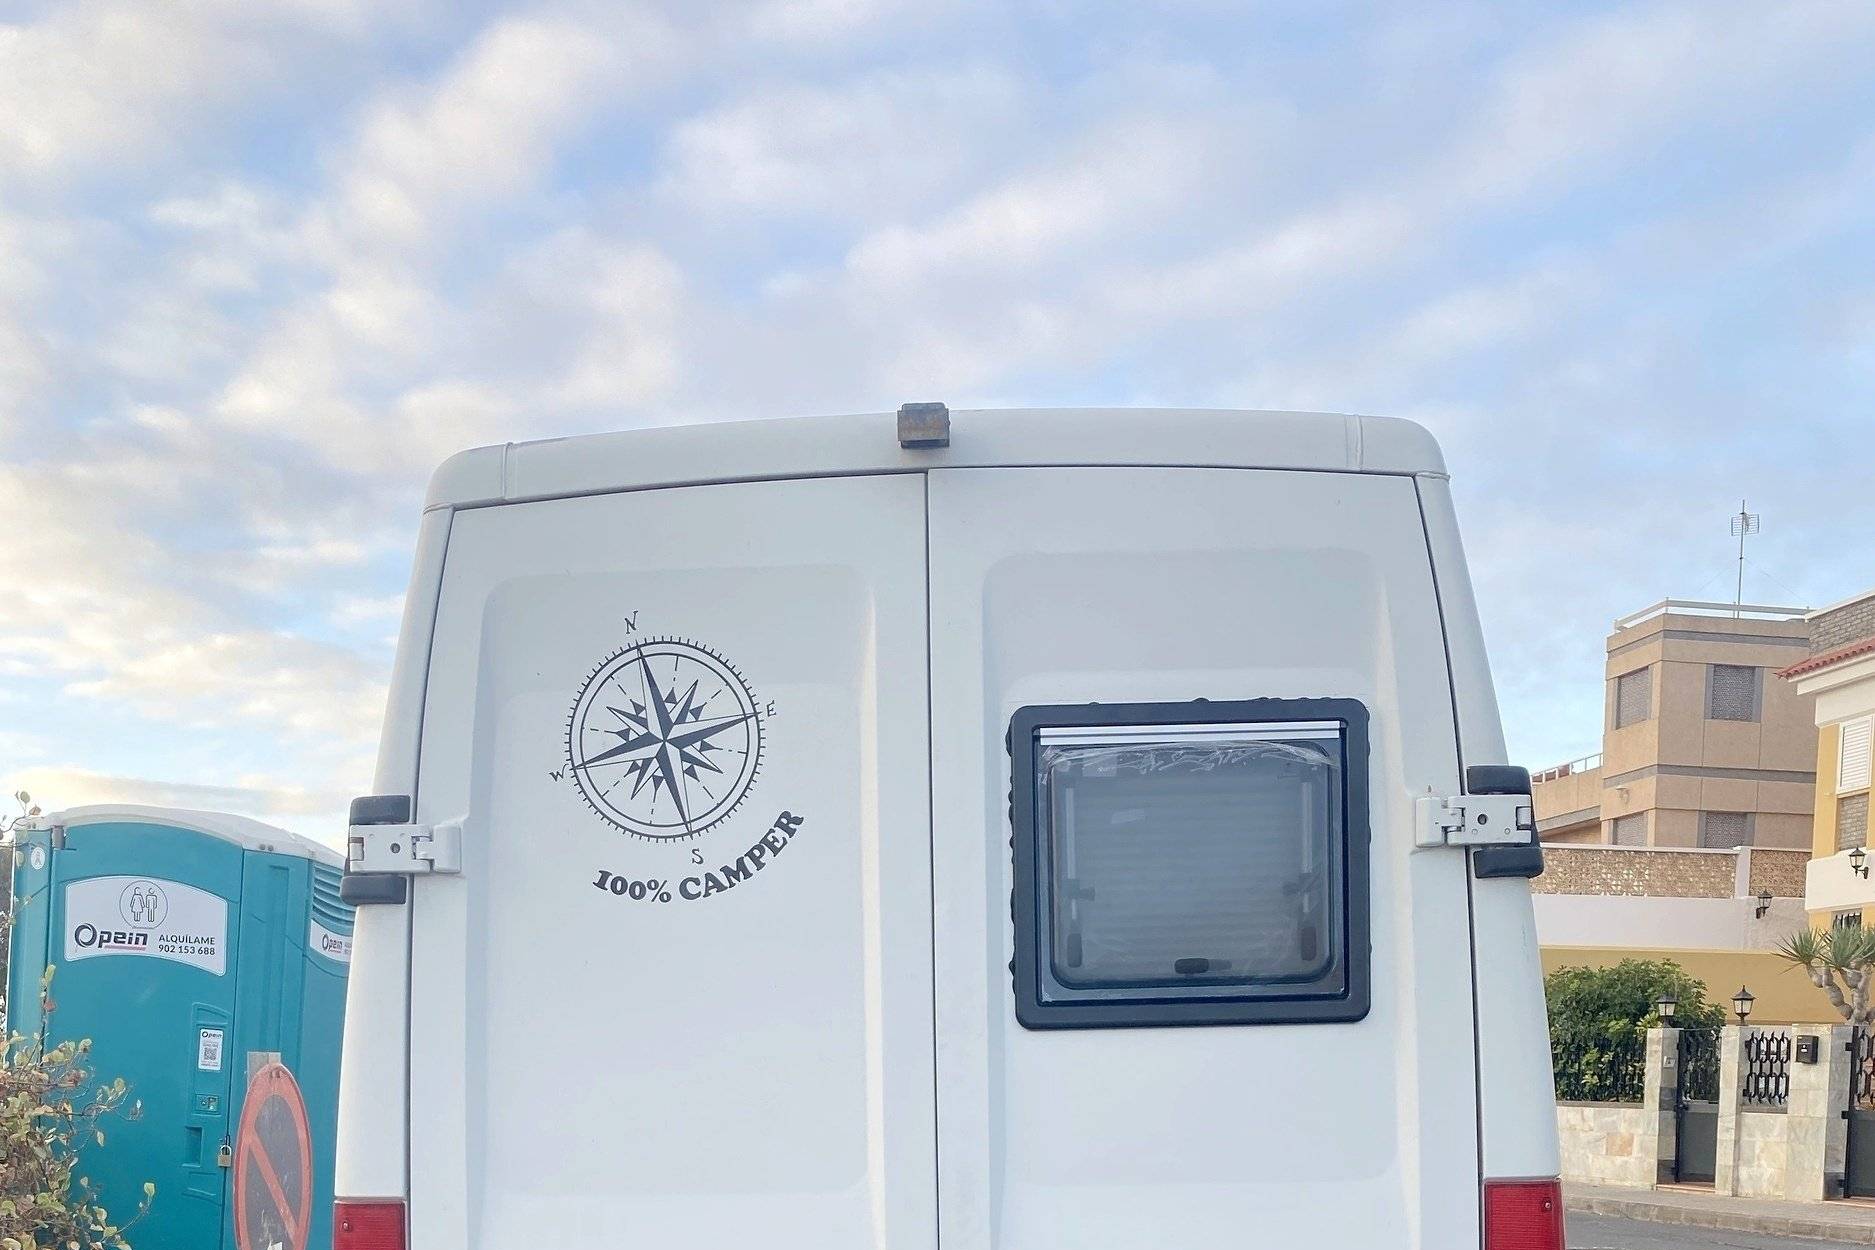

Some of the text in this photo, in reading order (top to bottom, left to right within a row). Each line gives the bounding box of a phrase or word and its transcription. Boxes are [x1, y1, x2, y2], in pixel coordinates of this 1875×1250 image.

[624, 610, 639, 635] N
[766, 699, 777, 717] E
[548, 762, 570, 782] W
[592, 809, 806, 904] 100% CAMPER
[691, 848, 705, 866] S
[74, 922, 149, 949] Opein
[158, 944, 216, 956] 902 153 688
